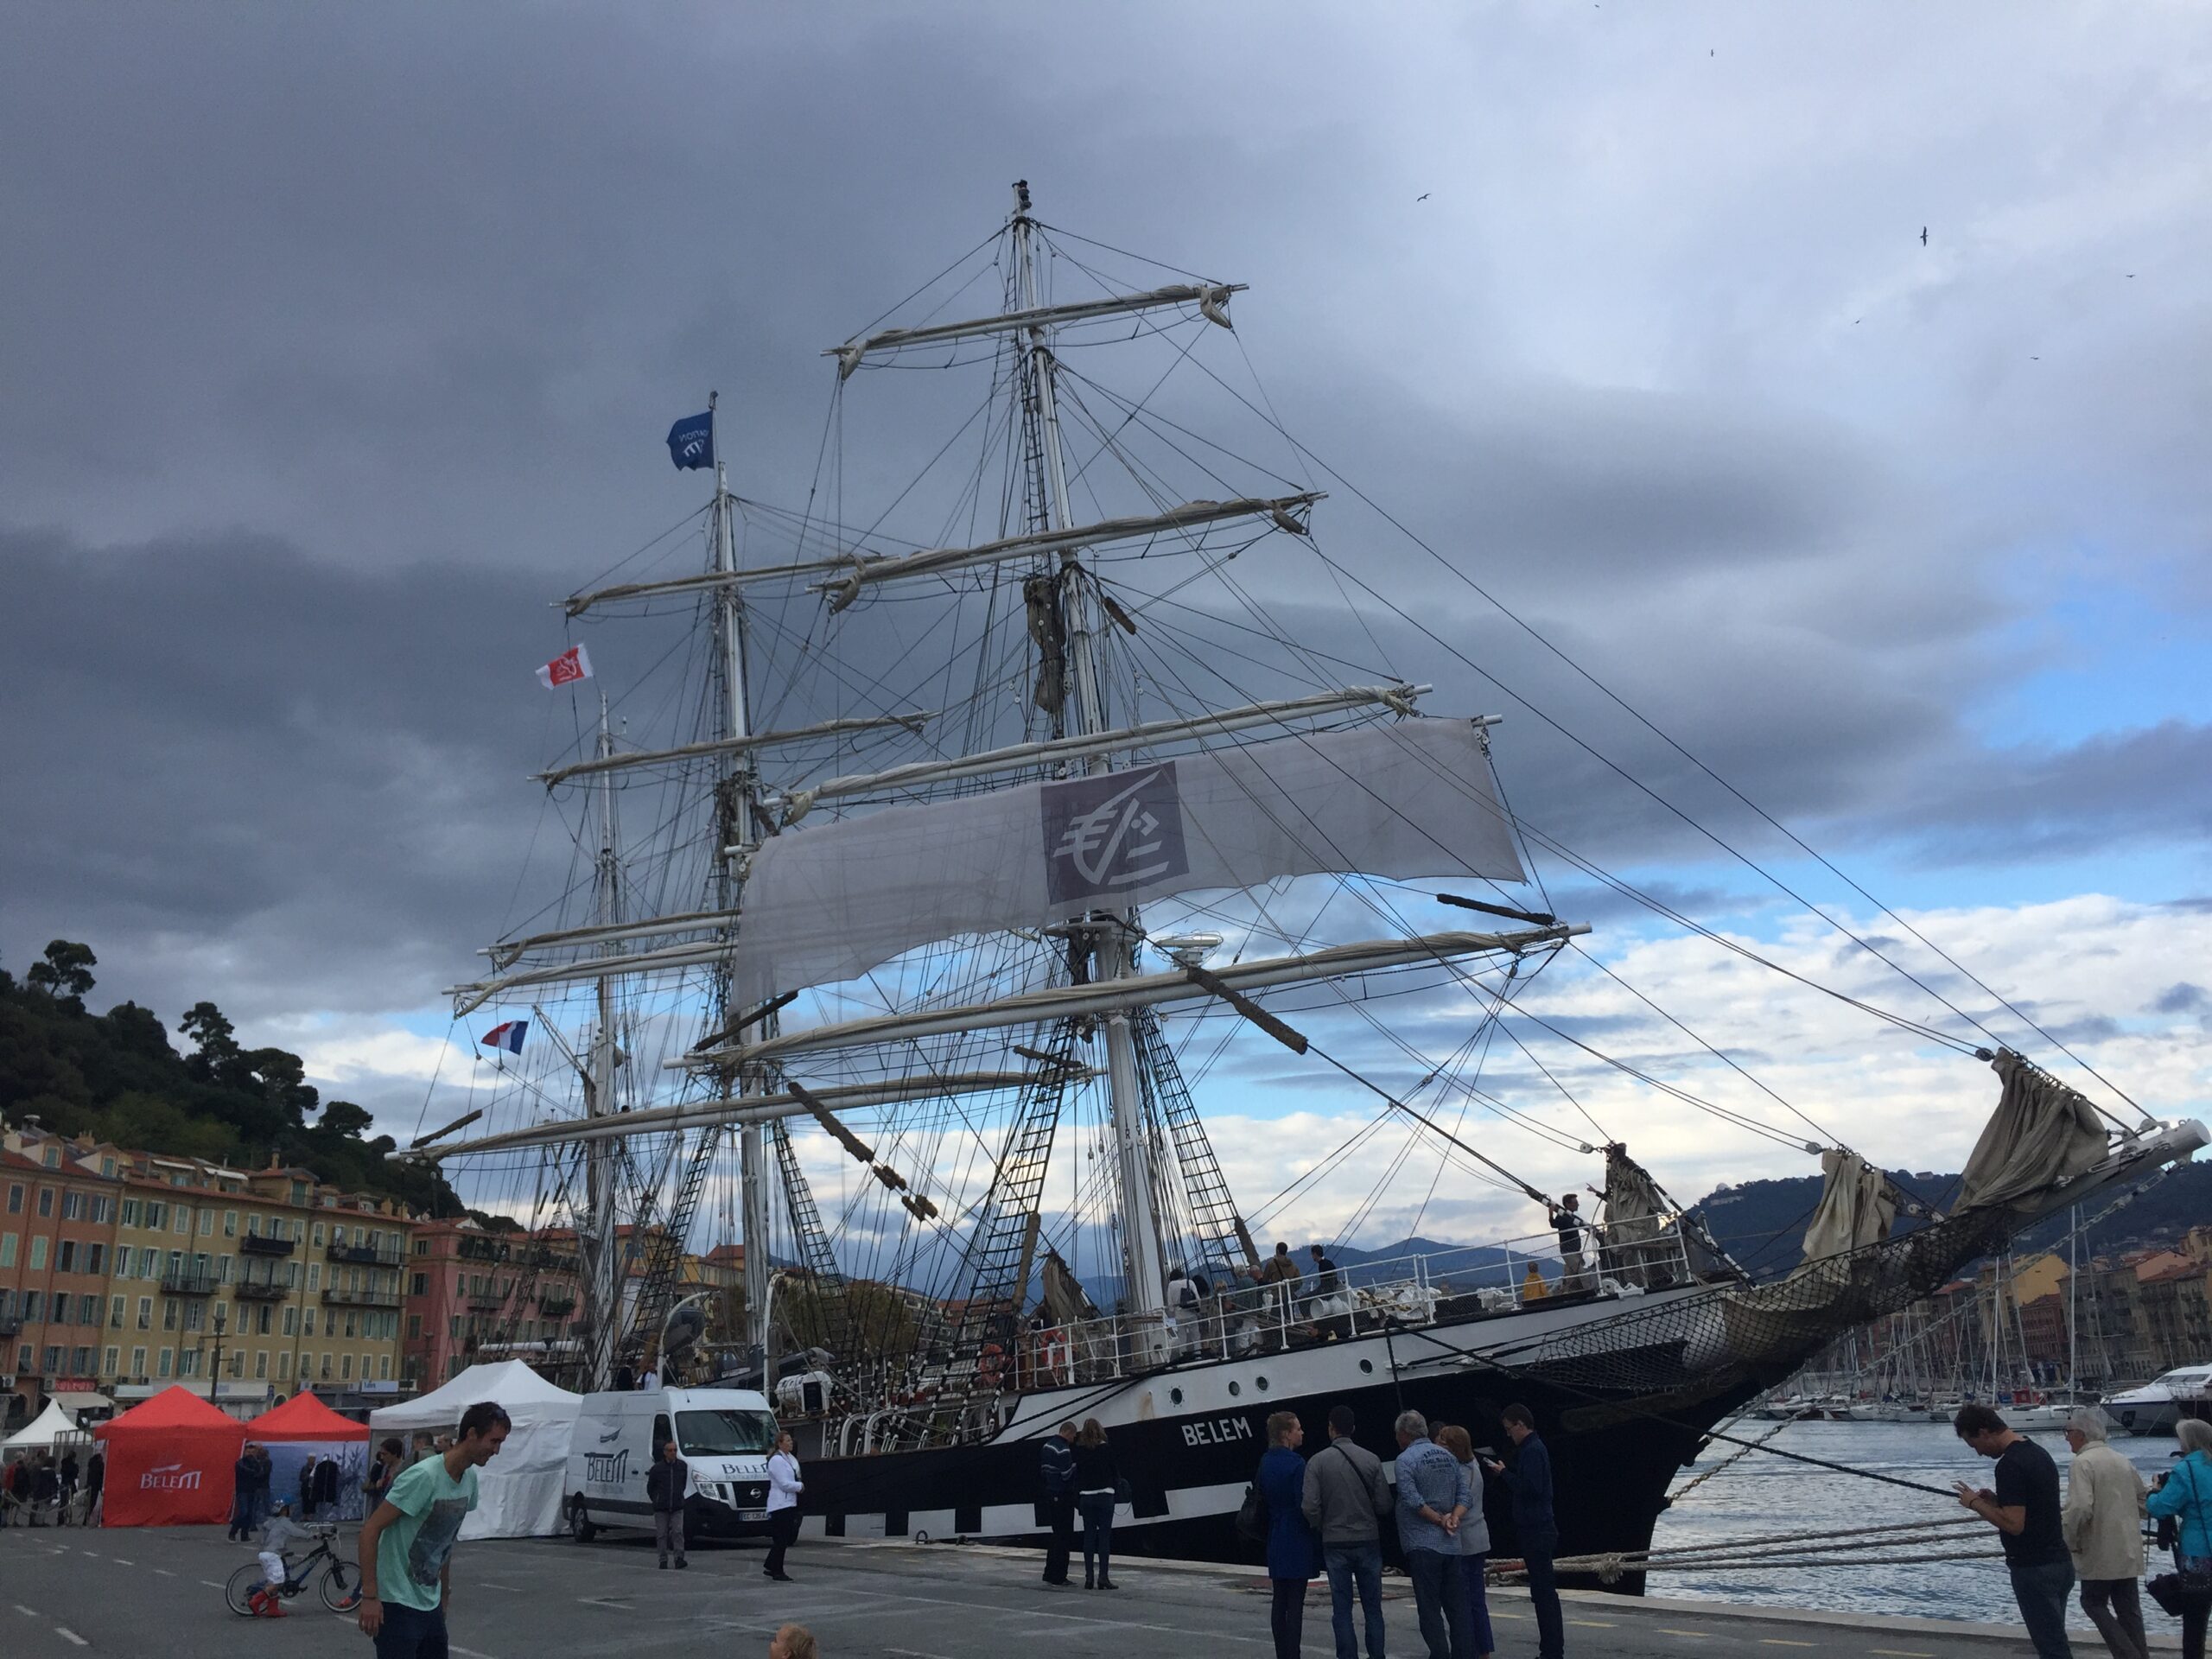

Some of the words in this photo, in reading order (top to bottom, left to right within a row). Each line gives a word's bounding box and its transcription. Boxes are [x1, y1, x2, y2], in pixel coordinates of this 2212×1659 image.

[1181, 1417, 1252, 1446] BELEM
[140, 1471, 202, 1490] BELEM
[587, 1448, 630, 1484] BELEM
